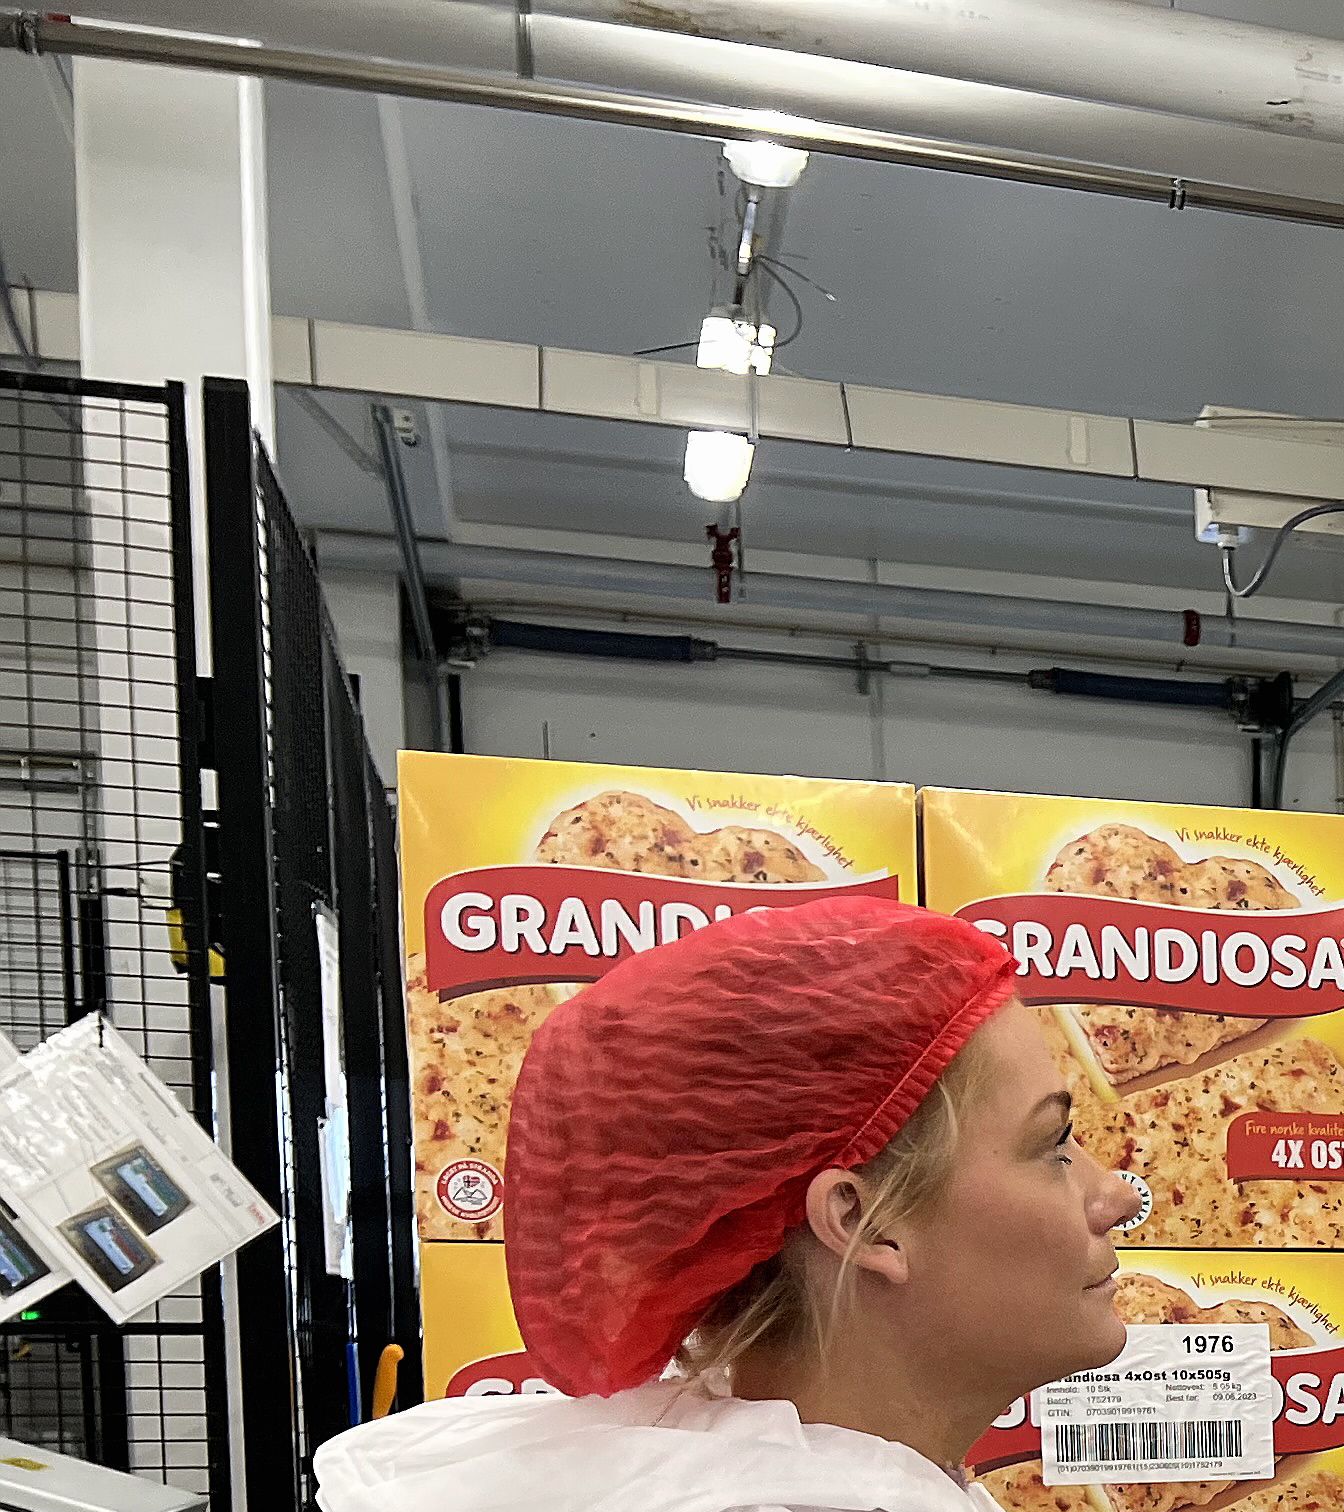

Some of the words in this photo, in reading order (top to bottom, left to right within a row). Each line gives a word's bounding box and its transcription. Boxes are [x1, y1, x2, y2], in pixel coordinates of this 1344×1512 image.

[686, 795, 702, 811] Vi
[1176, 828, 1190, 842] Vi
[1194, 827, 1242, 843] snakker
[1246, 835, 1271, 853] ekte
[1273, 846, 1326, 897] kjærlighet
[440, 892, 770, 957] GRAND
[1246, 1120, 1266, 1135] Fire
[1270, 1122, 1304, 1136] norske
[1272, 1139, 1304, 1168] 4X
[1191, 1273, 1205, 1288] Vi
[1209, 1271, 1257, 1286] snakker
[1261, 1277, 1286, 1295] ekte
[1288, 1286, 1341, 1334] kjærlighet
[1183, 1335, 1234, 1353] 1976
[1057, 1372, 1120, 1383] andiosa
[1125, 1371, 1167, 1382] 4xOst
[1172, 1370, 1230, 1382] 10x505g
